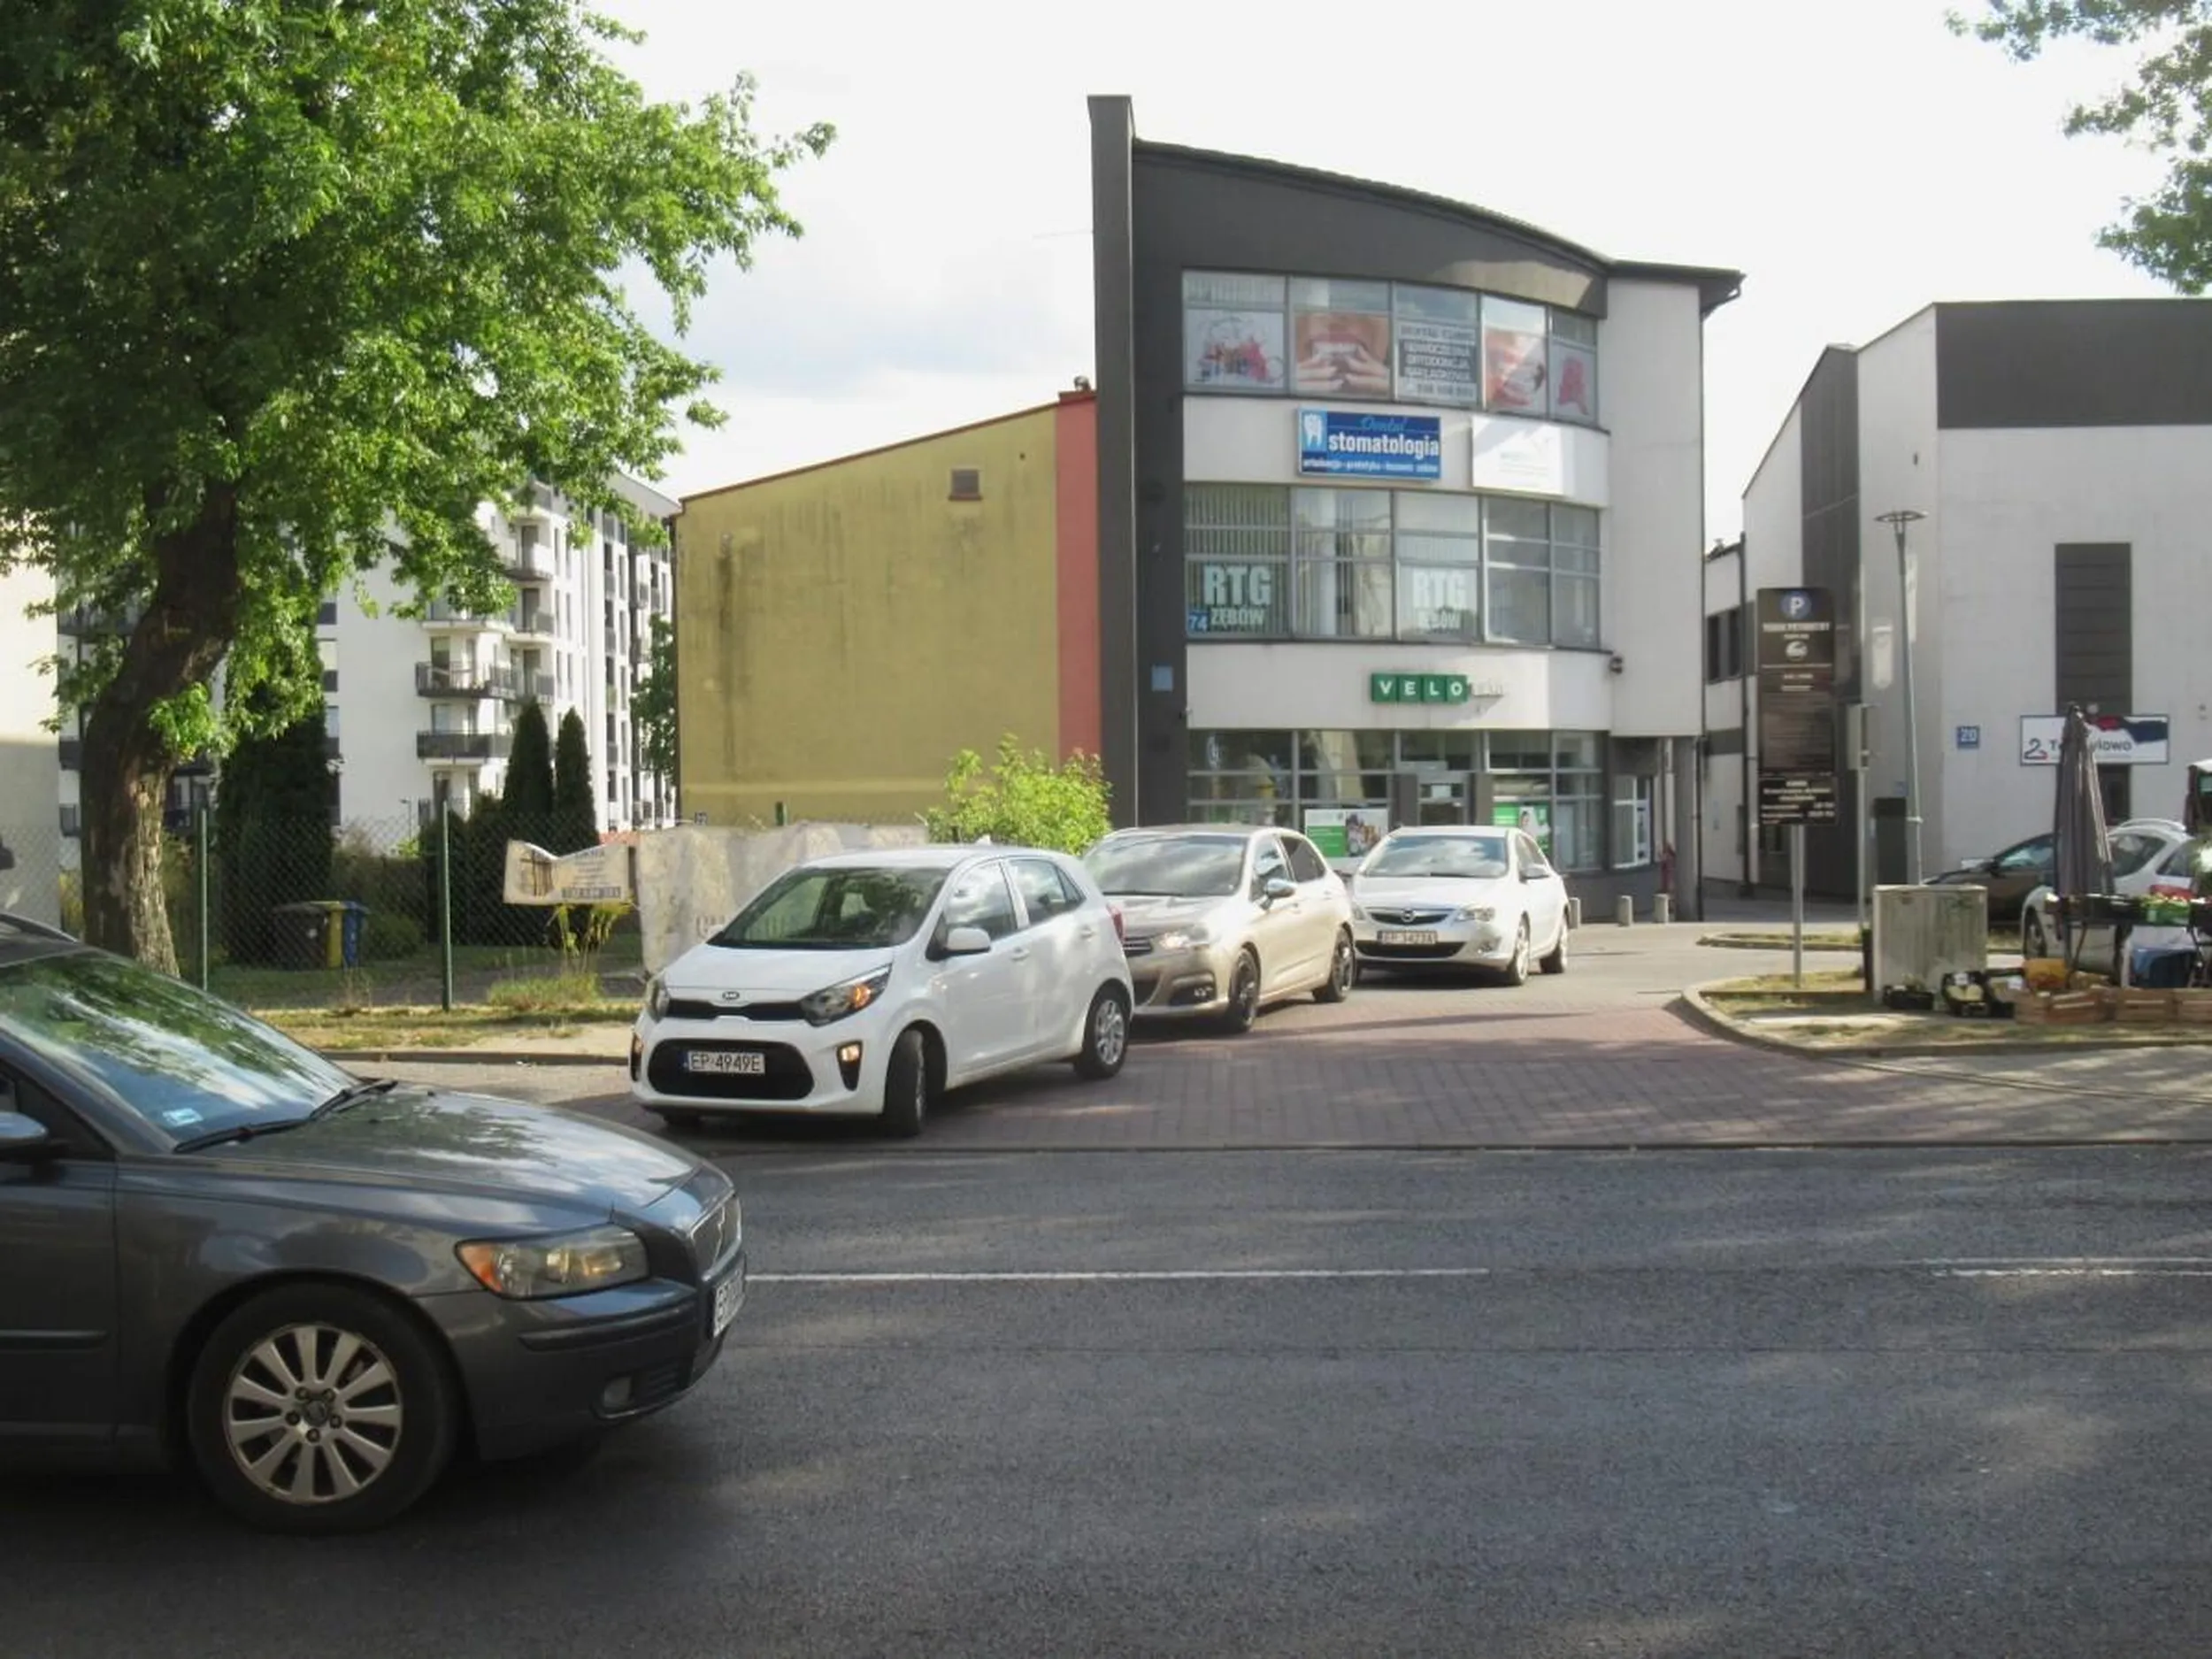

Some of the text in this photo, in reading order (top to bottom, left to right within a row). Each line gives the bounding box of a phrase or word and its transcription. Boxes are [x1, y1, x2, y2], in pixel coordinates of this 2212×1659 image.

[1328, 432, 1440, 460] stomatologia
[1204, 565, 1271, 606] RTG
[1413, 570, 1467, 609] RTG
[1379, 680, 1464, 696] VELO
[1960, 728, 1978, 742] 20
[690, 1053, 761, 1072] EP 4949E
